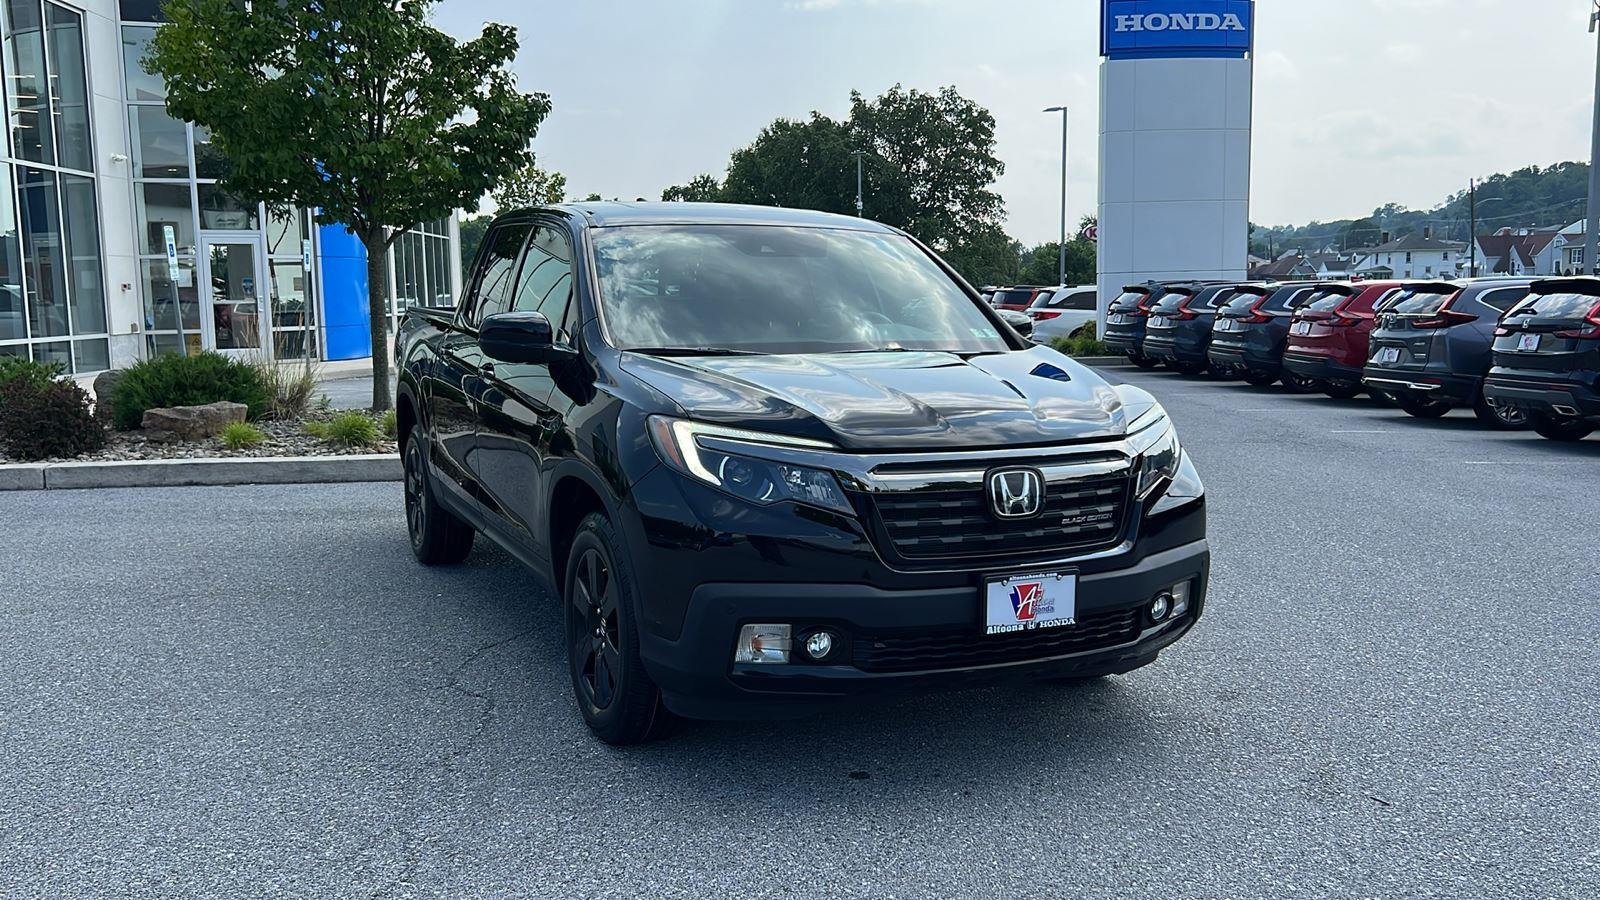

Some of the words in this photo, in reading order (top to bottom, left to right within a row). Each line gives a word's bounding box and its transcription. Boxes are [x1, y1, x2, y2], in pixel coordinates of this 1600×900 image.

[1114, 13, 1246, 32] HONDA
[1062, 516, 1086, 525] BLACK
[1087, 512, 1112, 521] EDITION
[987, 624, 1024, 635] Altoona
[1039, 618, 1076, 628] HONDA
